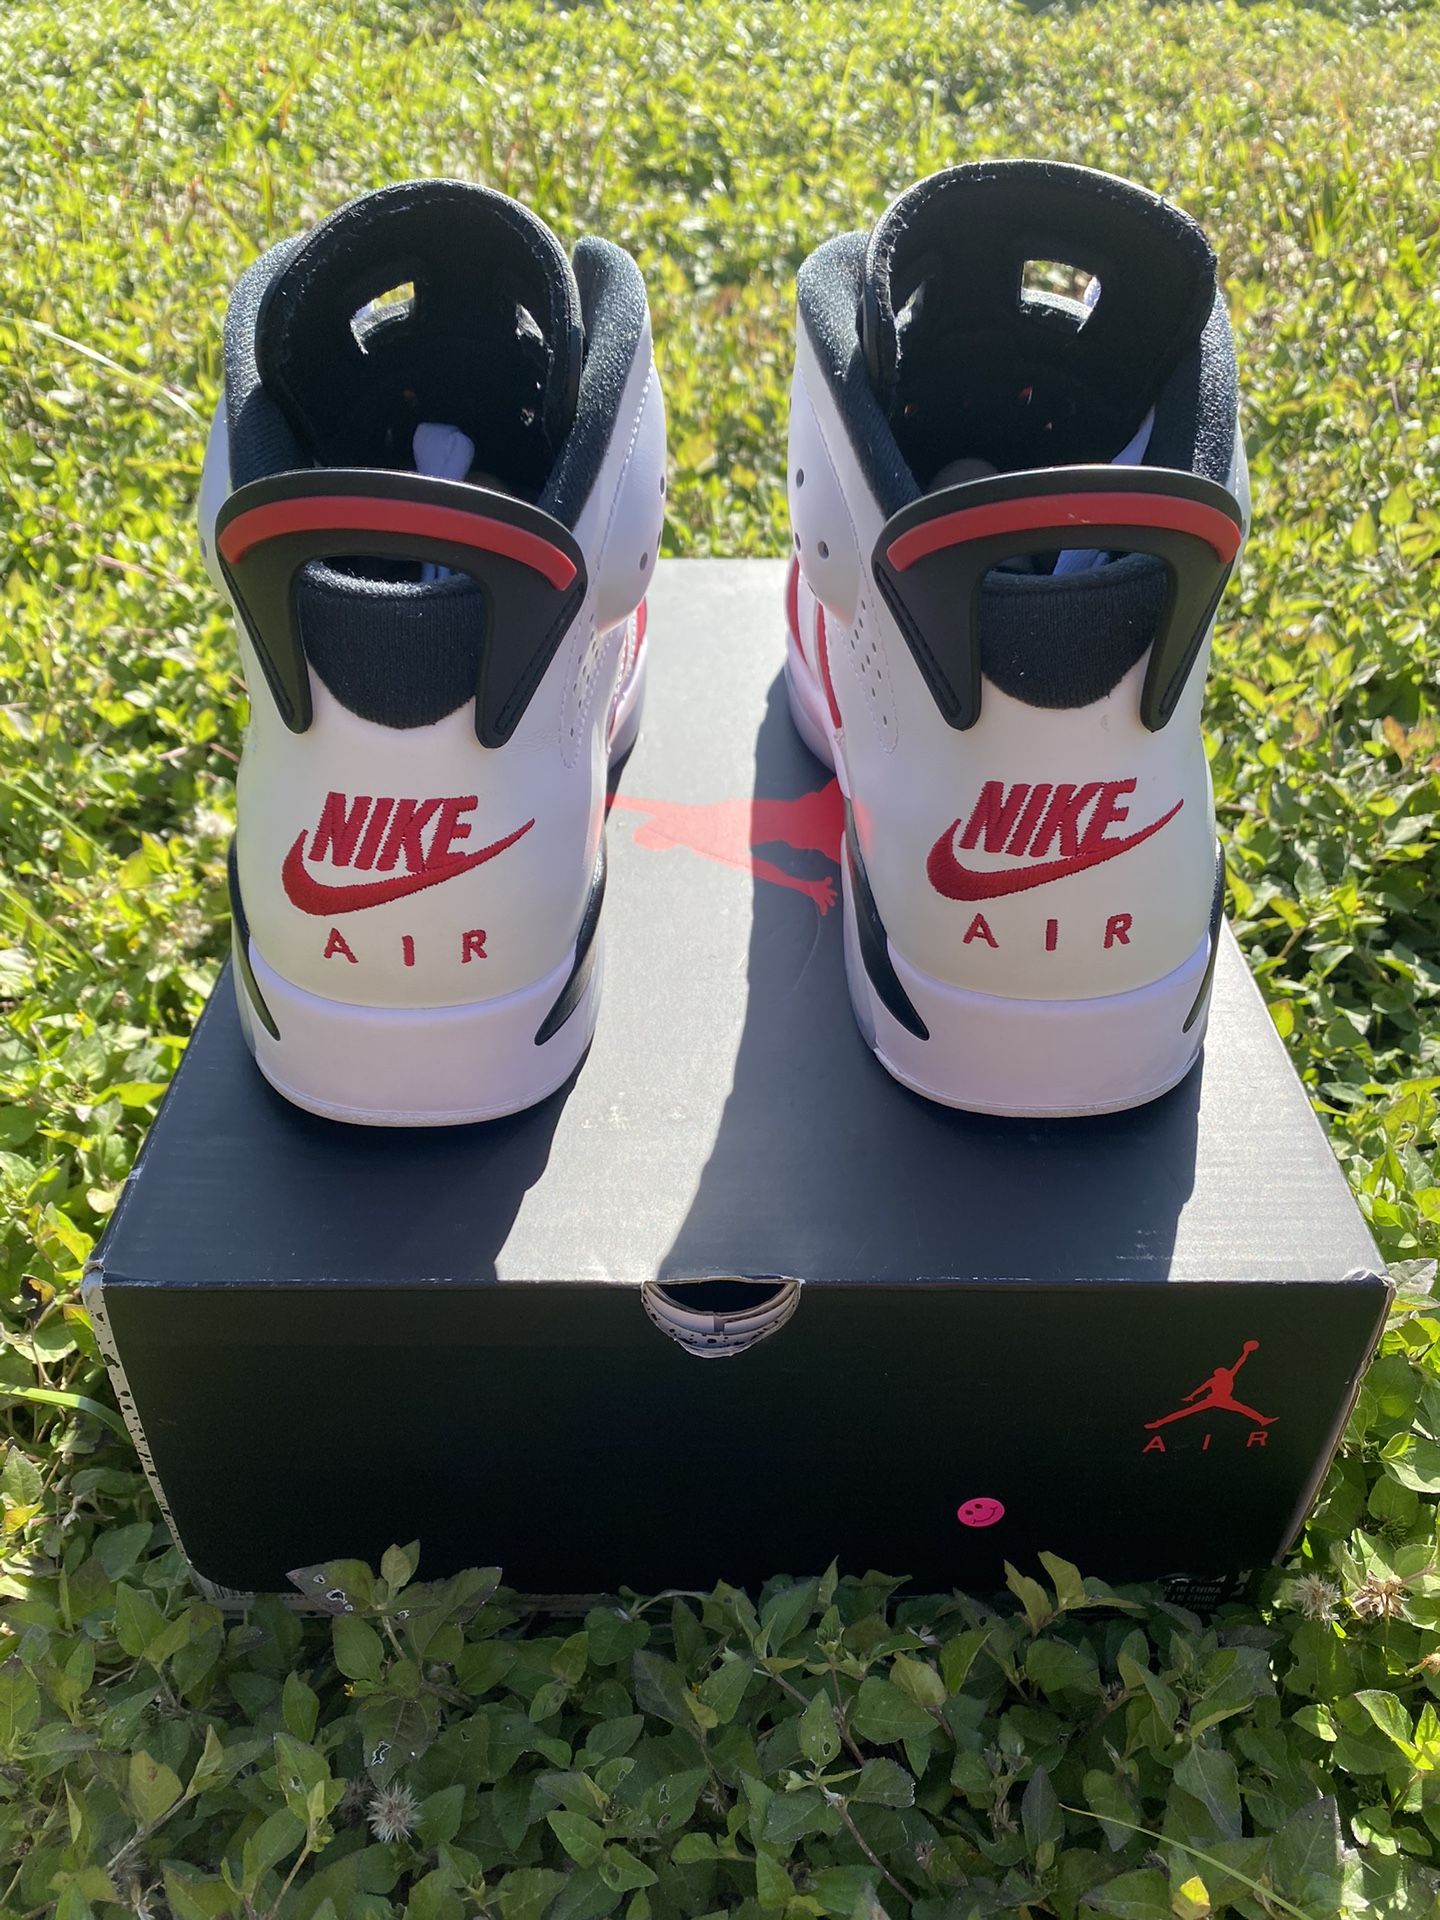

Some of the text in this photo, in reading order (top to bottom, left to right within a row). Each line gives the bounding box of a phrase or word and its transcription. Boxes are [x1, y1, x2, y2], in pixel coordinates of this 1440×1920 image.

[308, 791, 479, 873] NIKE
[958, 777, 1137, 857] NIKE
[323, 927, 488, 967] AIR
[963, 913, 1133, 951] AIR
[1142, 1431, 1269, 1453] AIR
